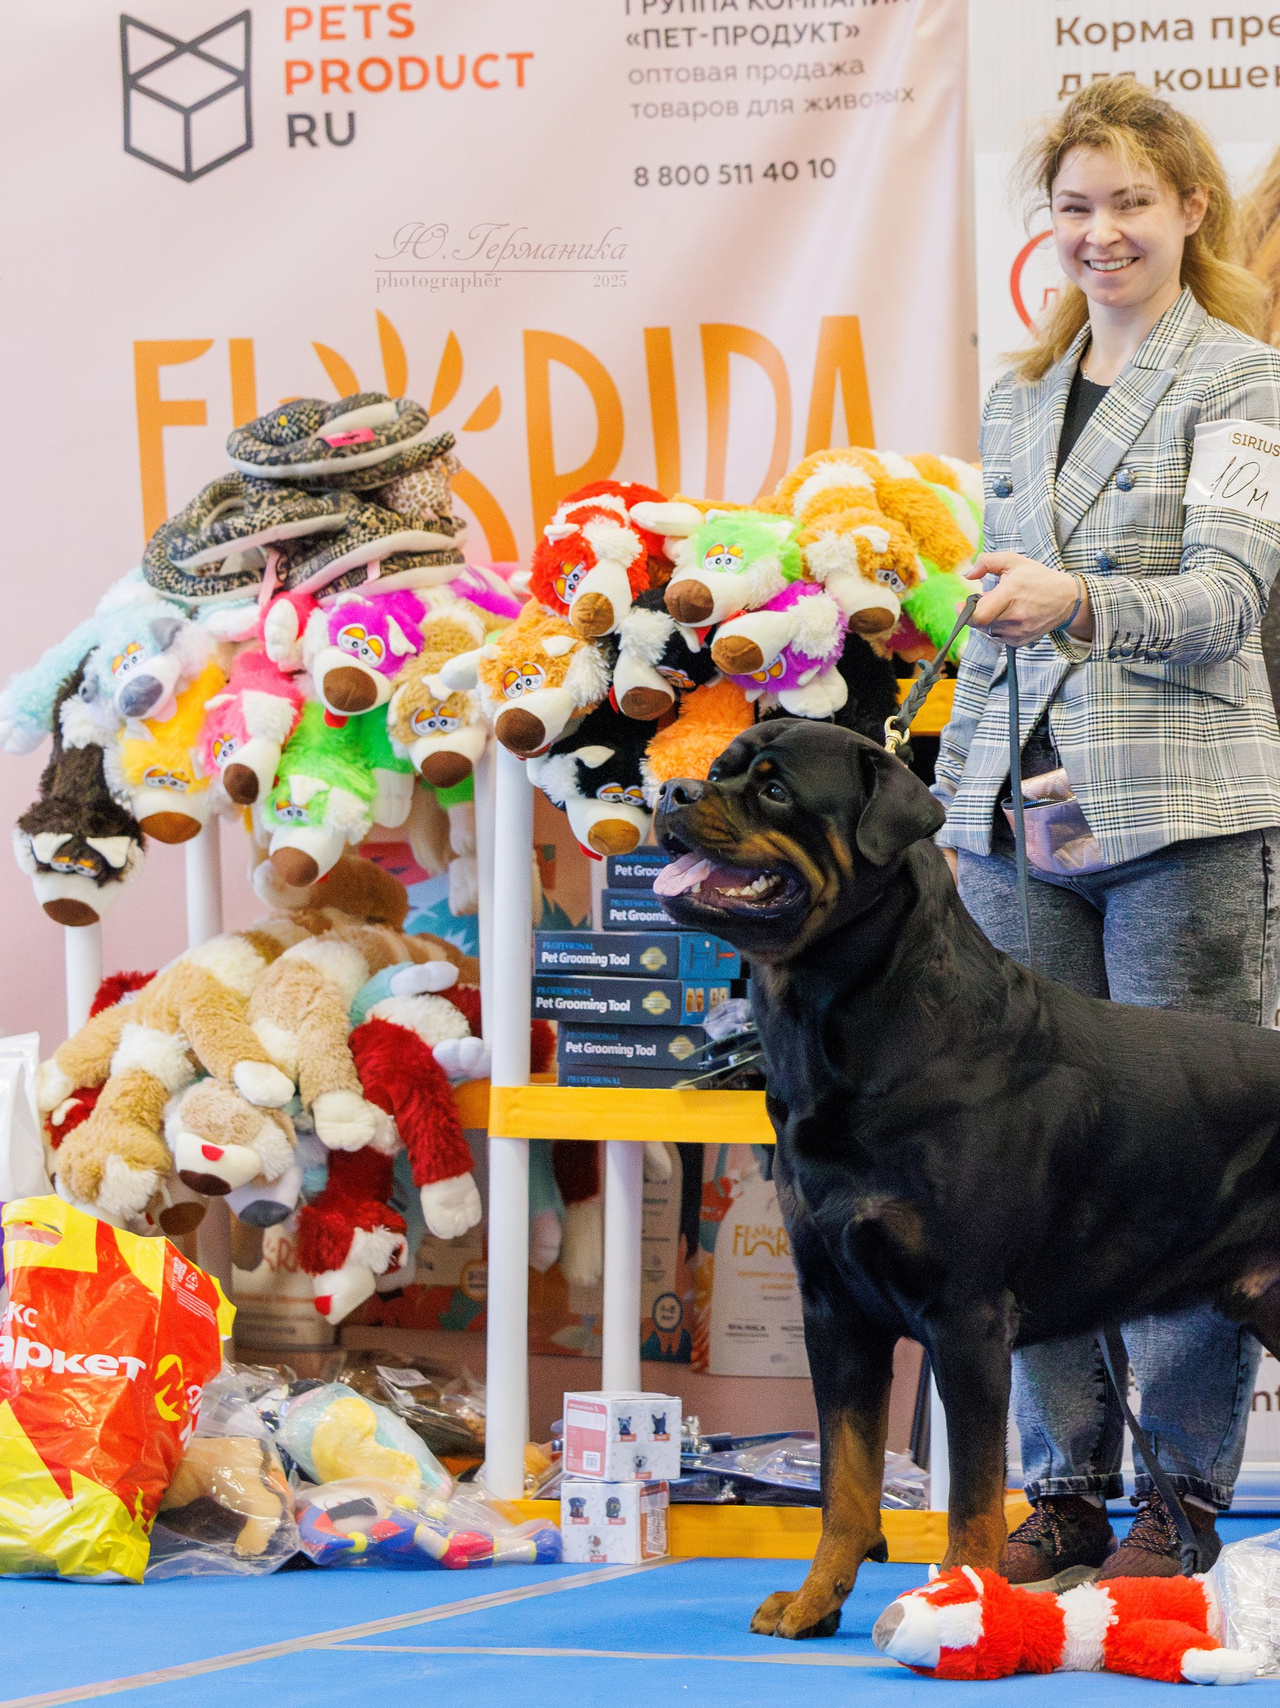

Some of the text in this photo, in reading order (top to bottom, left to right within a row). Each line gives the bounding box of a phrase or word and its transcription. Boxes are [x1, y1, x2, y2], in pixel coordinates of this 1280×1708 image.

[285, 3, 415, 42] PETS
[626, 21, 860, 49] «ПЕТ-ПРОДУКТ»
[1056, 16, 1193, 52] Корма
[284, 52, 534, 95] PRODUCT
[629, 58, 865, 85] оптовая продажа
[631, 99, 739, 121] товаров
[746, 97, 794, 118] для
[287, 111, 356, 148] RU
[634, 158, 836, 186] 8 800 511 40 10
[1231, 432, 1280, 457] SIRIUS
[614, 865, 663, 877] Pet Groo
[610, 909, 627, 920] Pet
[541, 952, 630, 967] Pet Grooming Tool
[536, 997, 630, 1013] Pet Grooming Tool
[565, 1042, 656, 1057] Pet Grooming Tool
[0, 1335, 146, 1382] аркет
